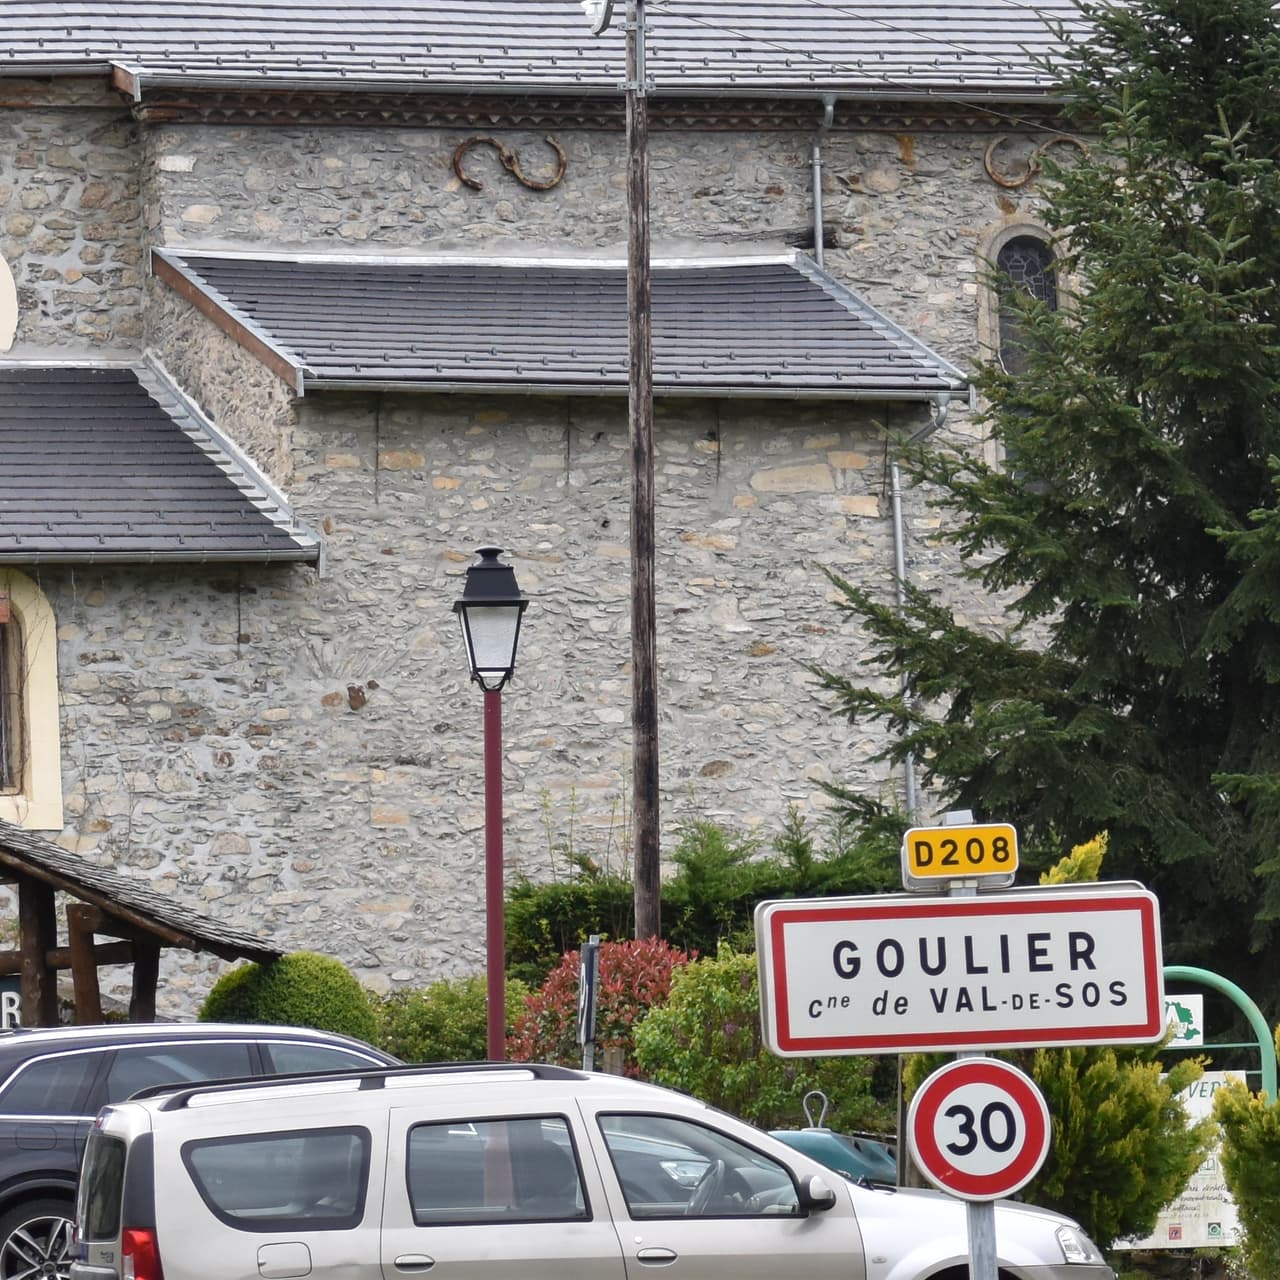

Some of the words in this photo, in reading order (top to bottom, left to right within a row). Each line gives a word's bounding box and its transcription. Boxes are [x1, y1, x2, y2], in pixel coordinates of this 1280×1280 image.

[915, 837, 1010, 868] D208
[832, 931, 1096, 980] GOULIER
[873, 990, 908, 1016] de
[930, 980, 1128, 1013] VAL-DE-SOS
[1188, 1080, 1228, 1099] VER
[944, 1101, 1017, 1157] 30
